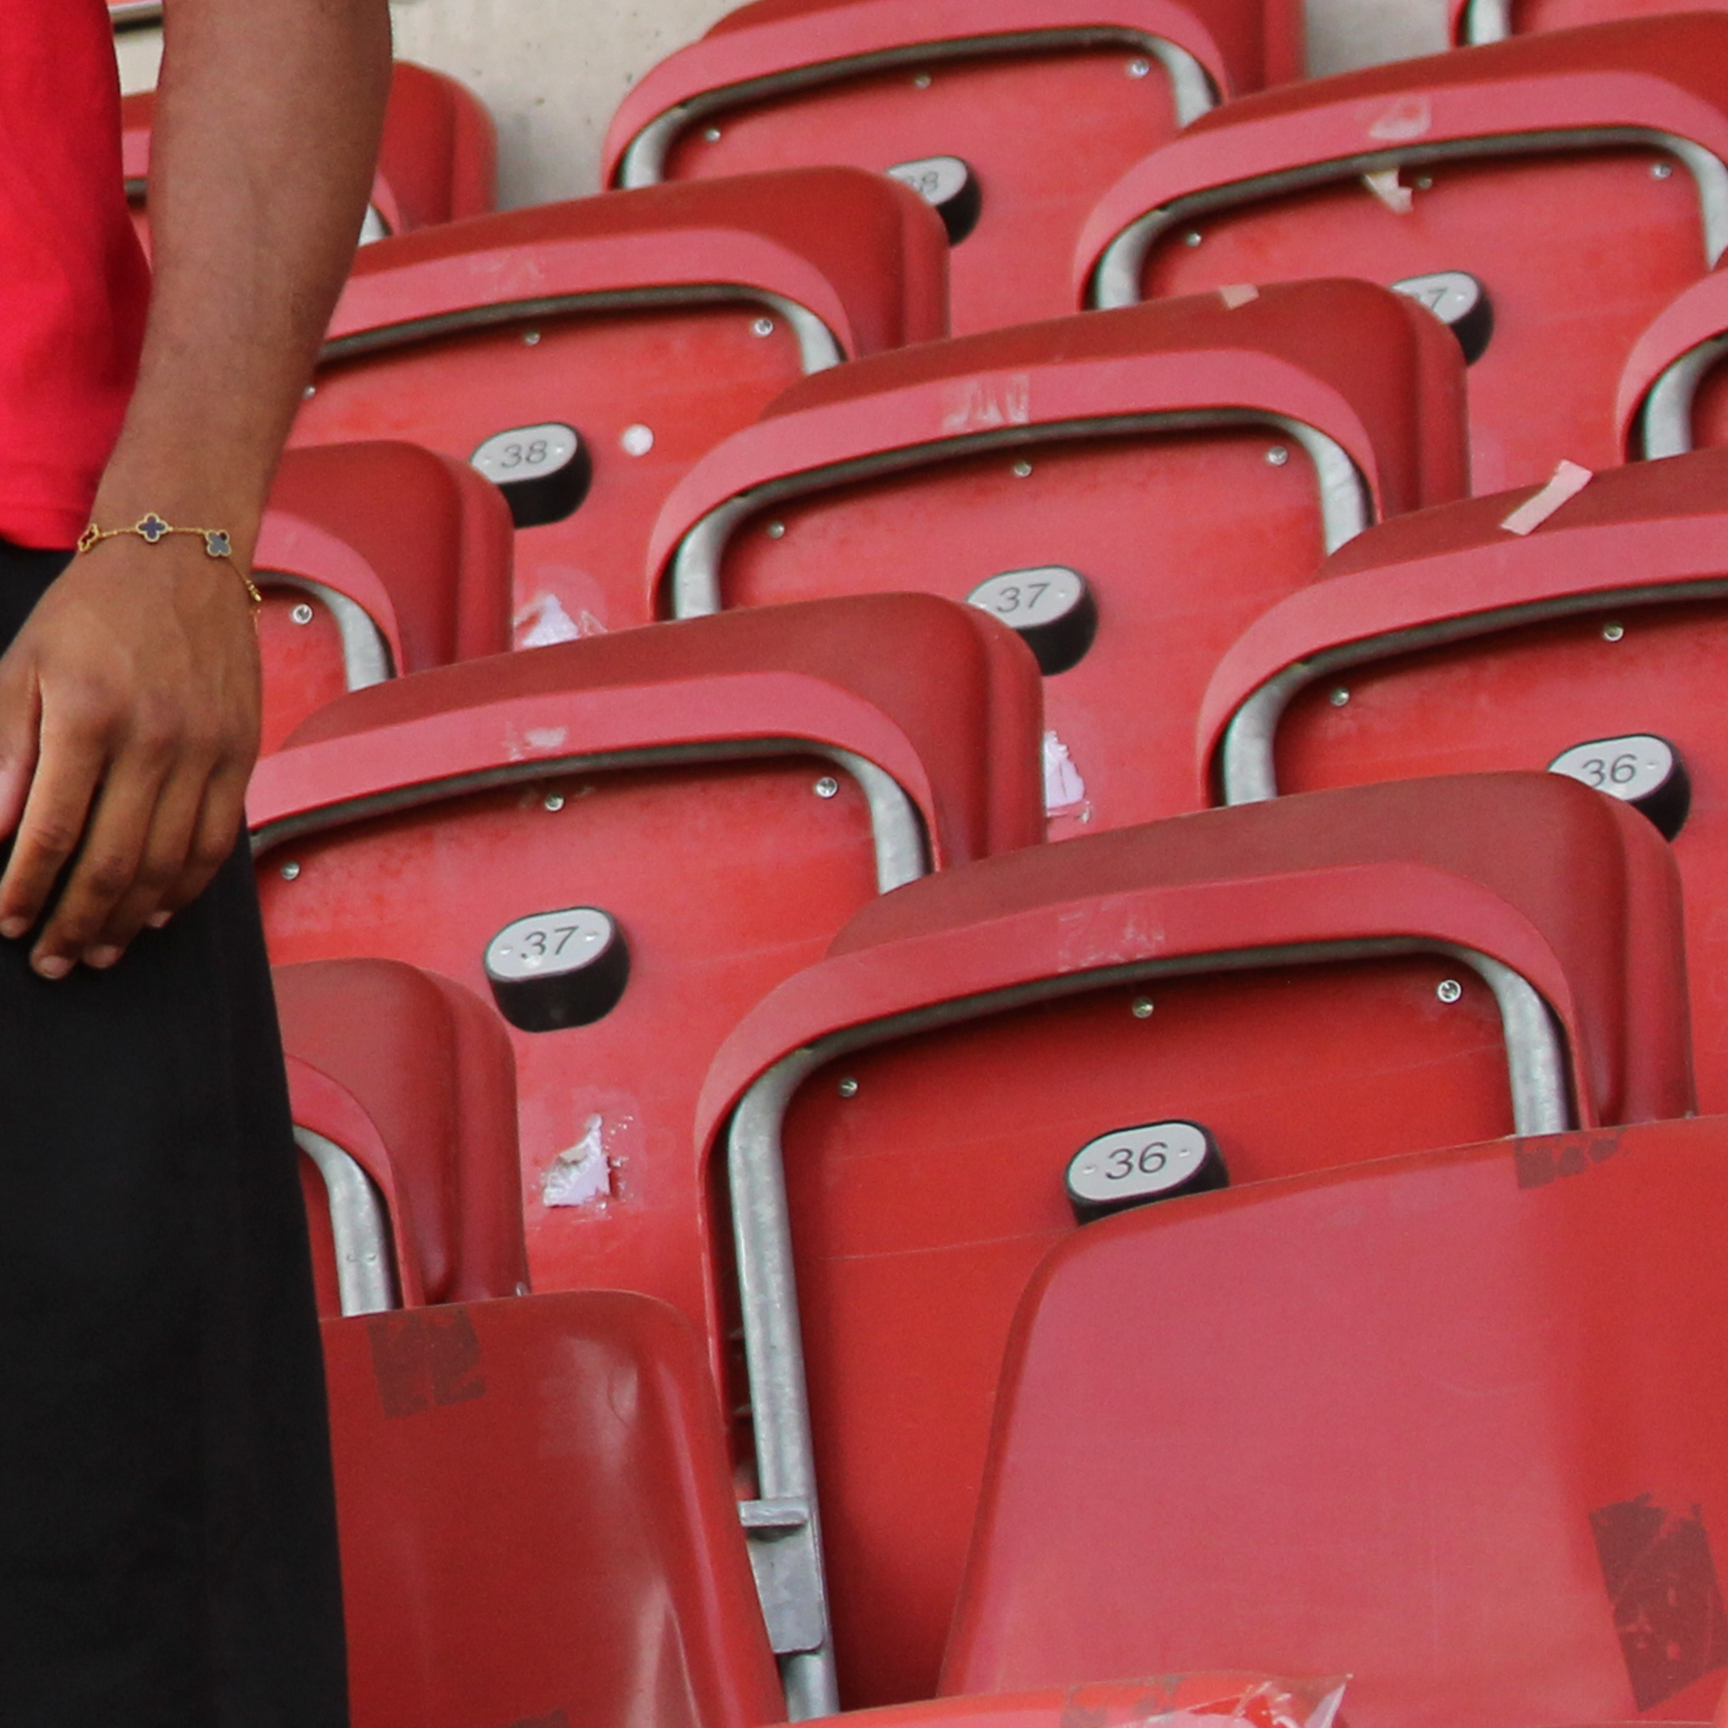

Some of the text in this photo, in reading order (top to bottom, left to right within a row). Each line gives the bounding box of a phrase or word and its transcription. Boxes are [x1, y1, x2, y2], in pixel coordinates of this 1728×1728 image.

[501, 439, 548, 468] 38
[996, 582, 1051, 613] 37
[1582, 753, 1638, 788] 36
[520, 924, 580, 960] 37
[1105, 1141, 1169, 1180] 36
